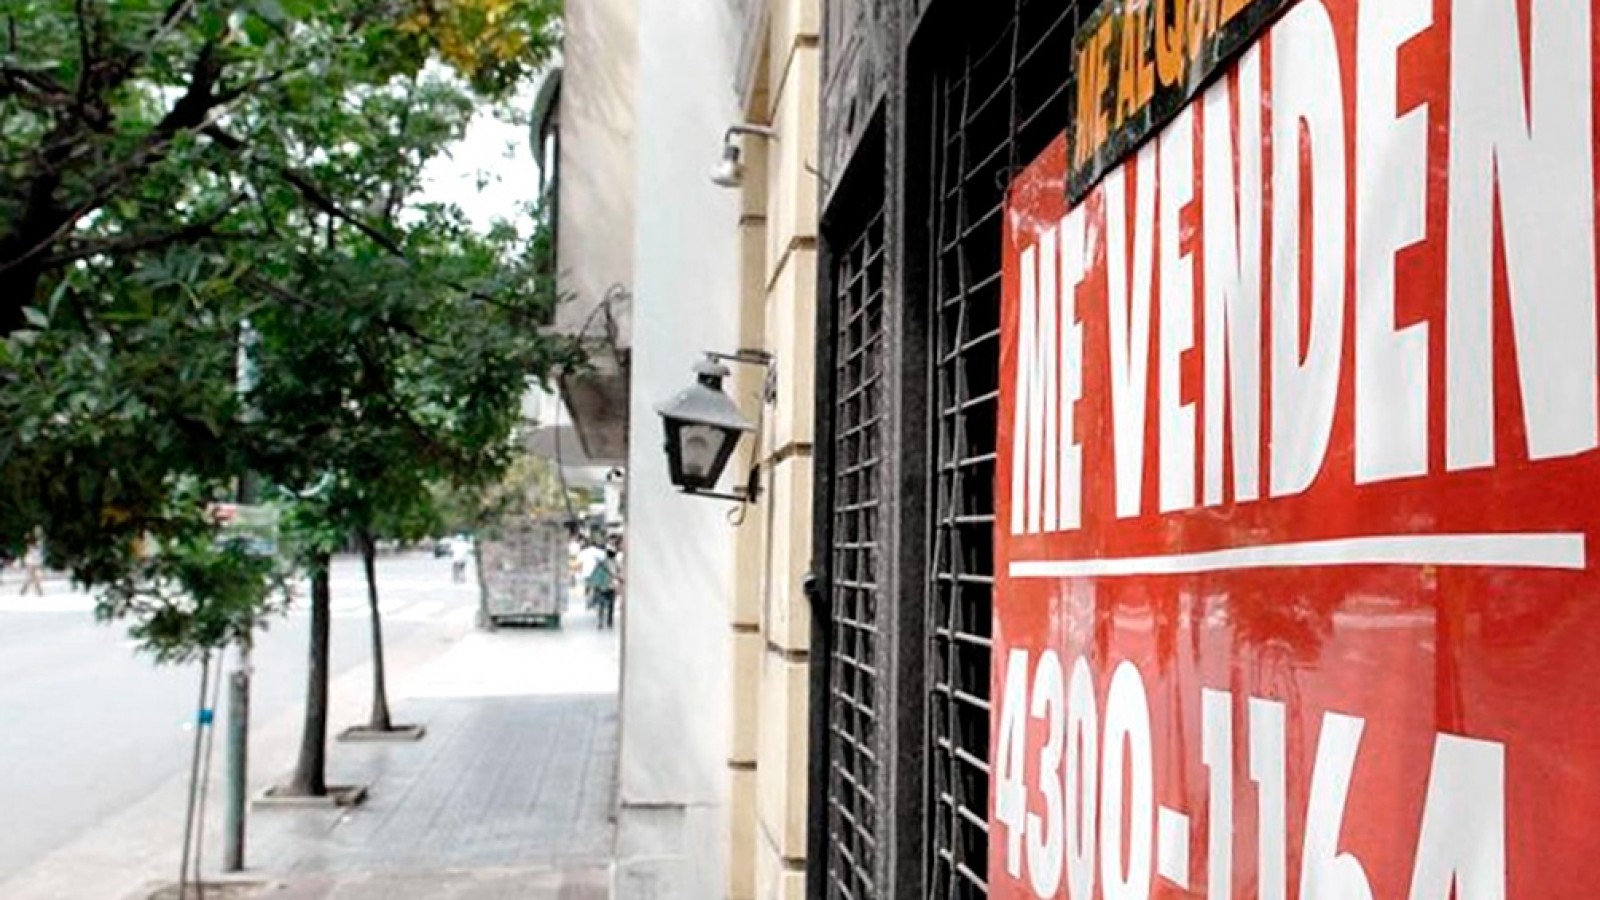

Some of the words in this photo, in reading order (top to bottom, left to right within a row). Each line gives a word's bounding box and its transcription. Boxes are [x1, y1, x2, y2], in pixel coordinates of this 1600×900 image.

[1074, 15, 1112, 172] ME
[1115, 0, 1252, 128] ALQU
[1010, 204, 1088, 536] ME
[1100, 0, 1598, 520] VENDEN
